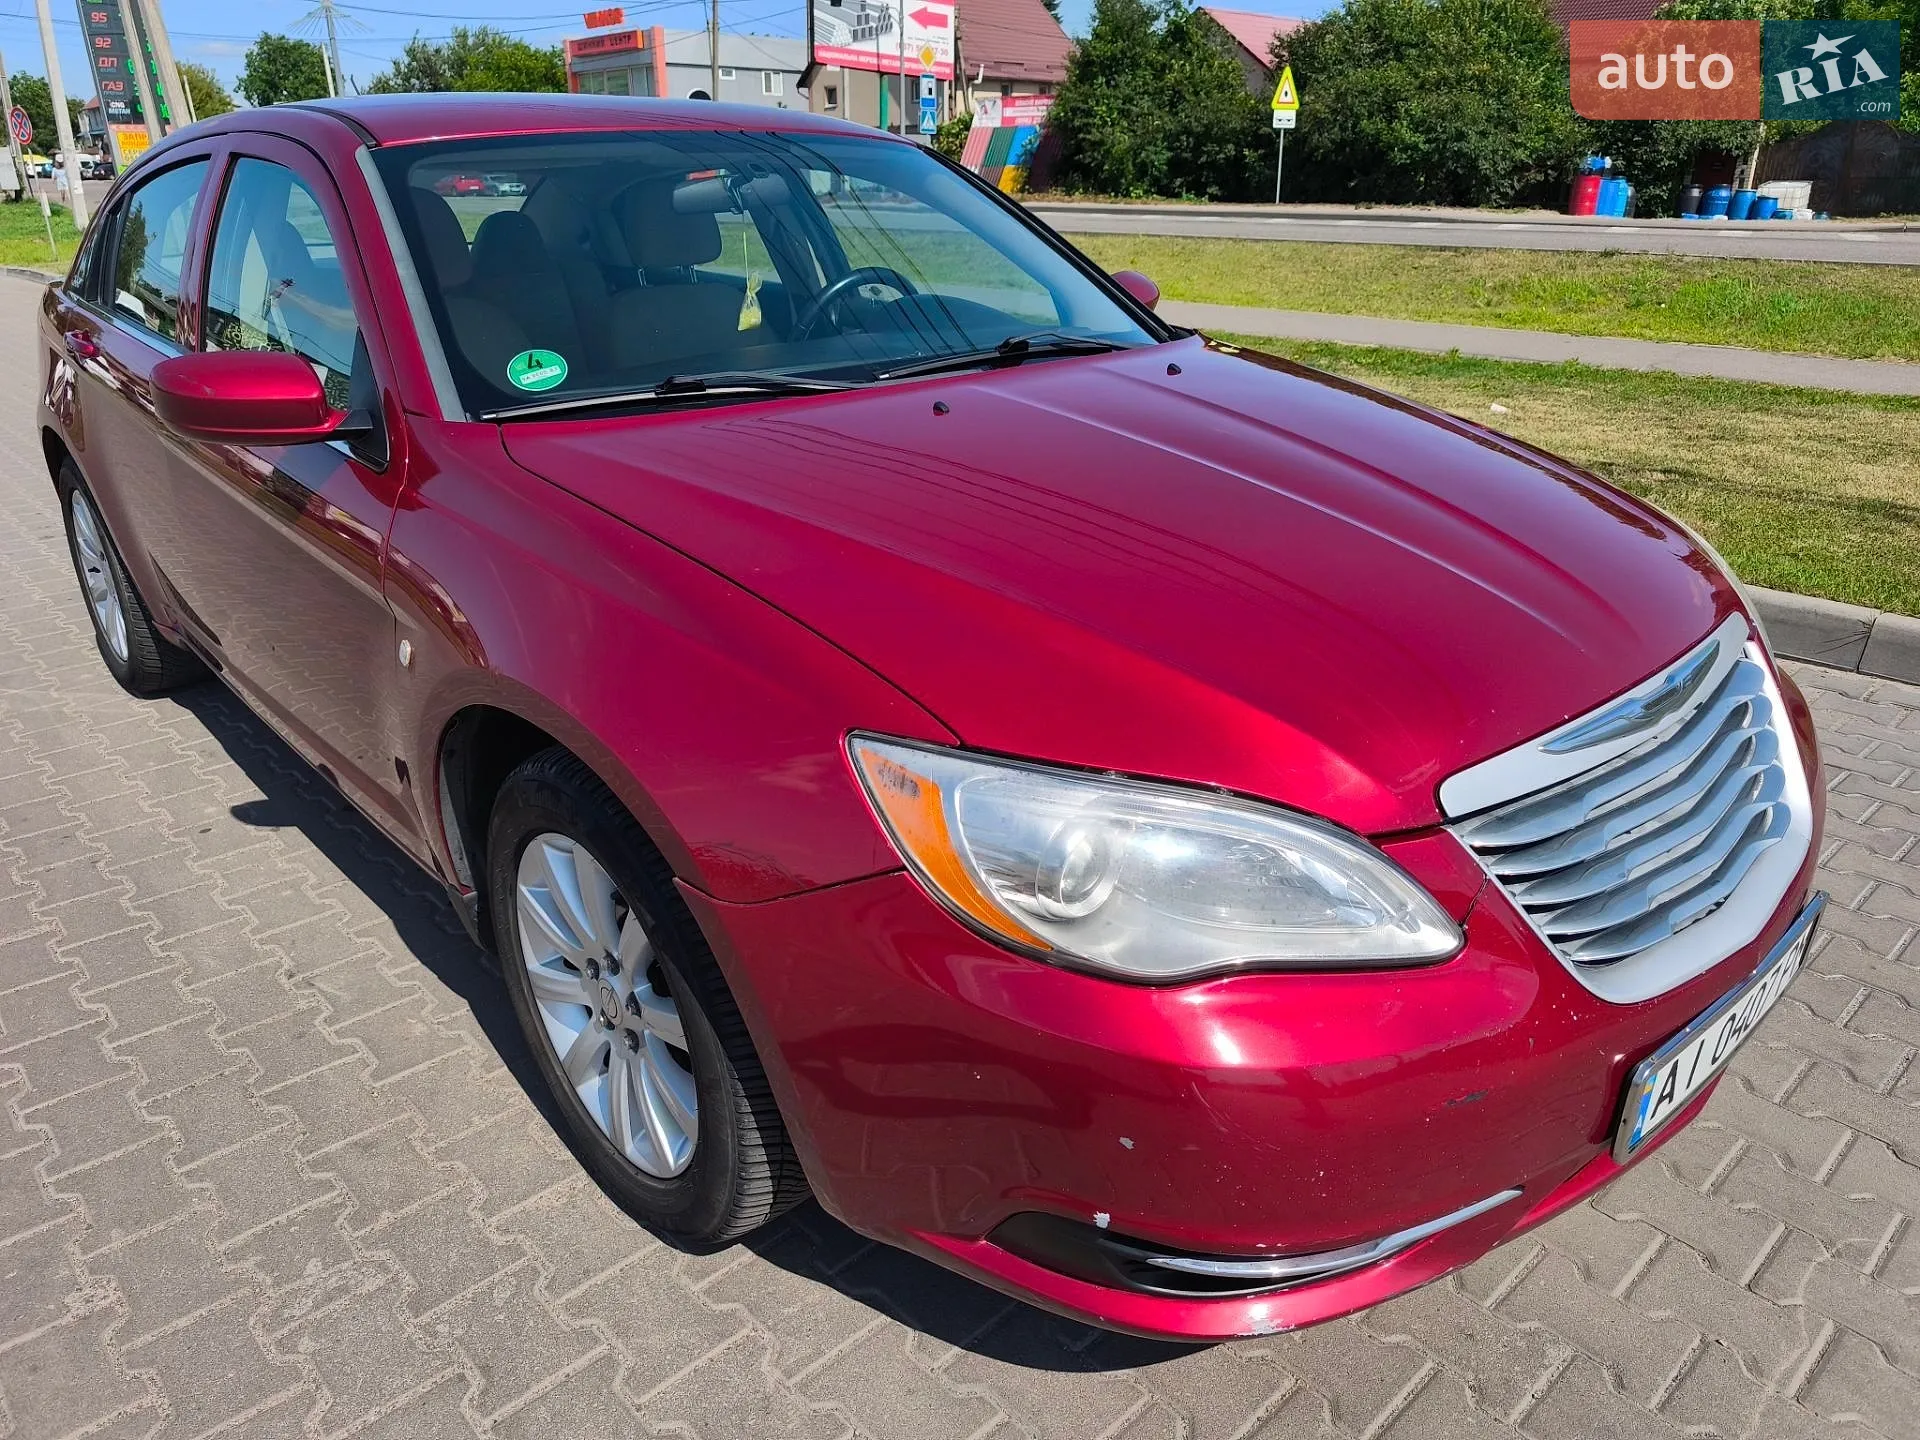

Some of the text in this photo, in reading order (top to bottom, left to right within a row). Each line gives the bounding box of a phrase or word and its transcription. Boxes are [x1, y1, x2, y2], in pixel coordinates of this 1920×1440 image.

[91, 12, 108, 23] 95
[95, 37, 112, 48] 92
[98, 57, 117, 67] ДП
[102, 81, 124, 91] ГАЗ
[527, 352, 544, 370] 4
